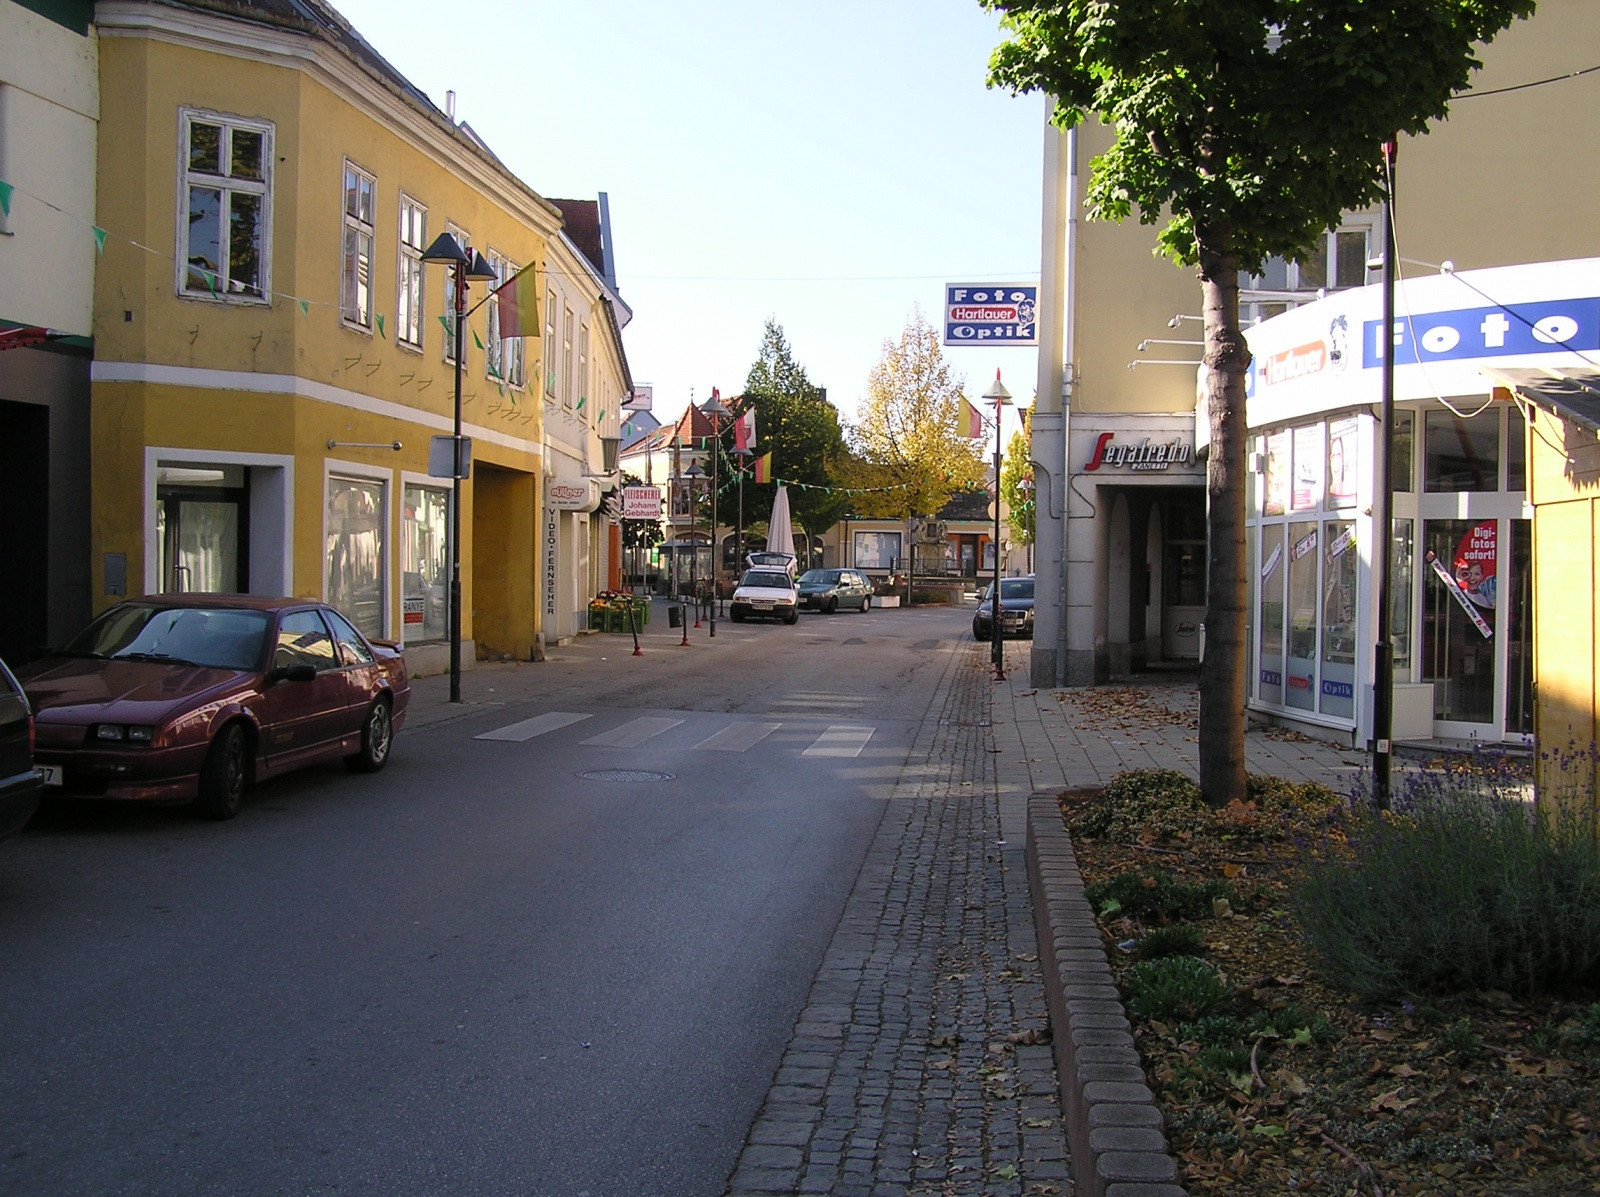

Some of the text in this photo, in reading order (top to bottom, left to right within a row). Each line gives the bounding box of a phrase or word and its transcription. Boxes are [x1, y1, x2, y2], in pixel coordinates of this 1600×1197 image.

[954, 289, 1026, 302] Foto
[956, 307, 1012, 320] Hartlauer
[952, 325, 1031, 339] Optik
[1375, 313, 1579, 359] Foto
[1084, 432, 1191, 471] Segafredo
[624, 489, 660, 500] FLEISCHEREI
[629, 501, 657, 509] Johann
[625, 509, 660, 517] Gebhardt
[1474, 527, 1496, 538] Digi-
[1470, 539, 1495, 549] fotos
[1464, 549, 1495, 560] sofort!
[547, 551, 555, 615] FERNSEHER
[1324, 682, 1351, 696] Optik
